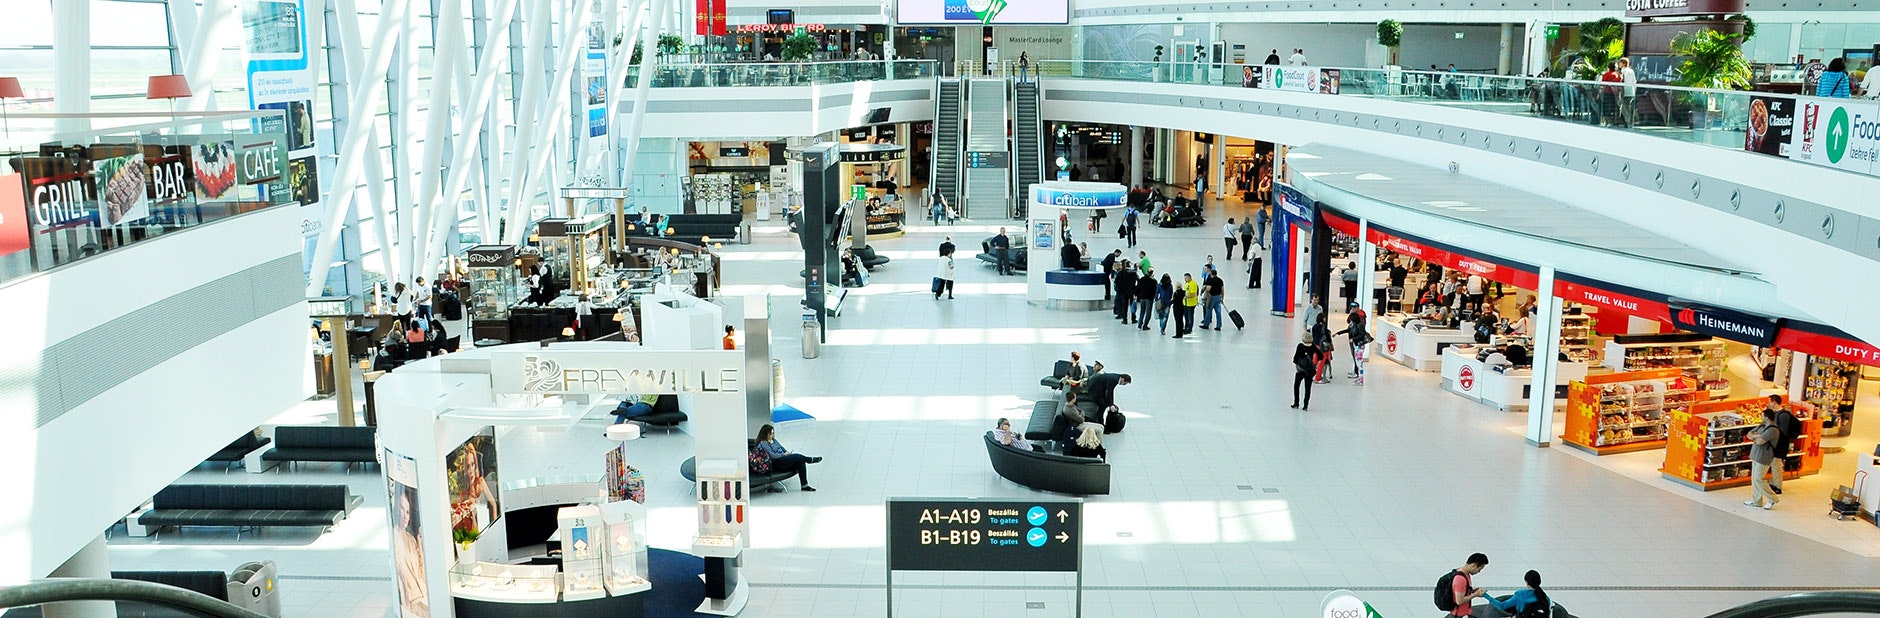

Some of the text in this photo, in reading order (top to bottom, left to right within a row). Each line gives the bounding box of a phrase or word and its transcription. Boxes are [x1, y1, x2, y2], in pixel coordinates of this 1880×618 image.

[1625, 0, 1651, 11] COSTA
[1770, 101, 1782, 111] KFC
[1769, 114, 1792, 127] Classic
[1801, 143, 1813, 153] KFC
[243, 139, 281, 180] CAFÉ
[153, 161, 187, 199] BAR
[34, 180, 90, 226] GRILL
[1055, 193, 1099, 206] citibank
[1458, 260, 1487, 273] DUTY FREE
[1584, 291, 1637, 311] TRAVEL VALUE
[1699, 313, 1764, 338] HEINEMANN
[1835, 344, 1868, 358] DUTY
[562, 369, 739, 392] FREYWILLE
[988, 508, 1019, 516] Beszállás
[999, 517, 1019, 525] gates
[988, 529, 1019, 537] Beszállás
[999, 538, 1019, 546] gates
[1331, 608, 1359, 618] food
